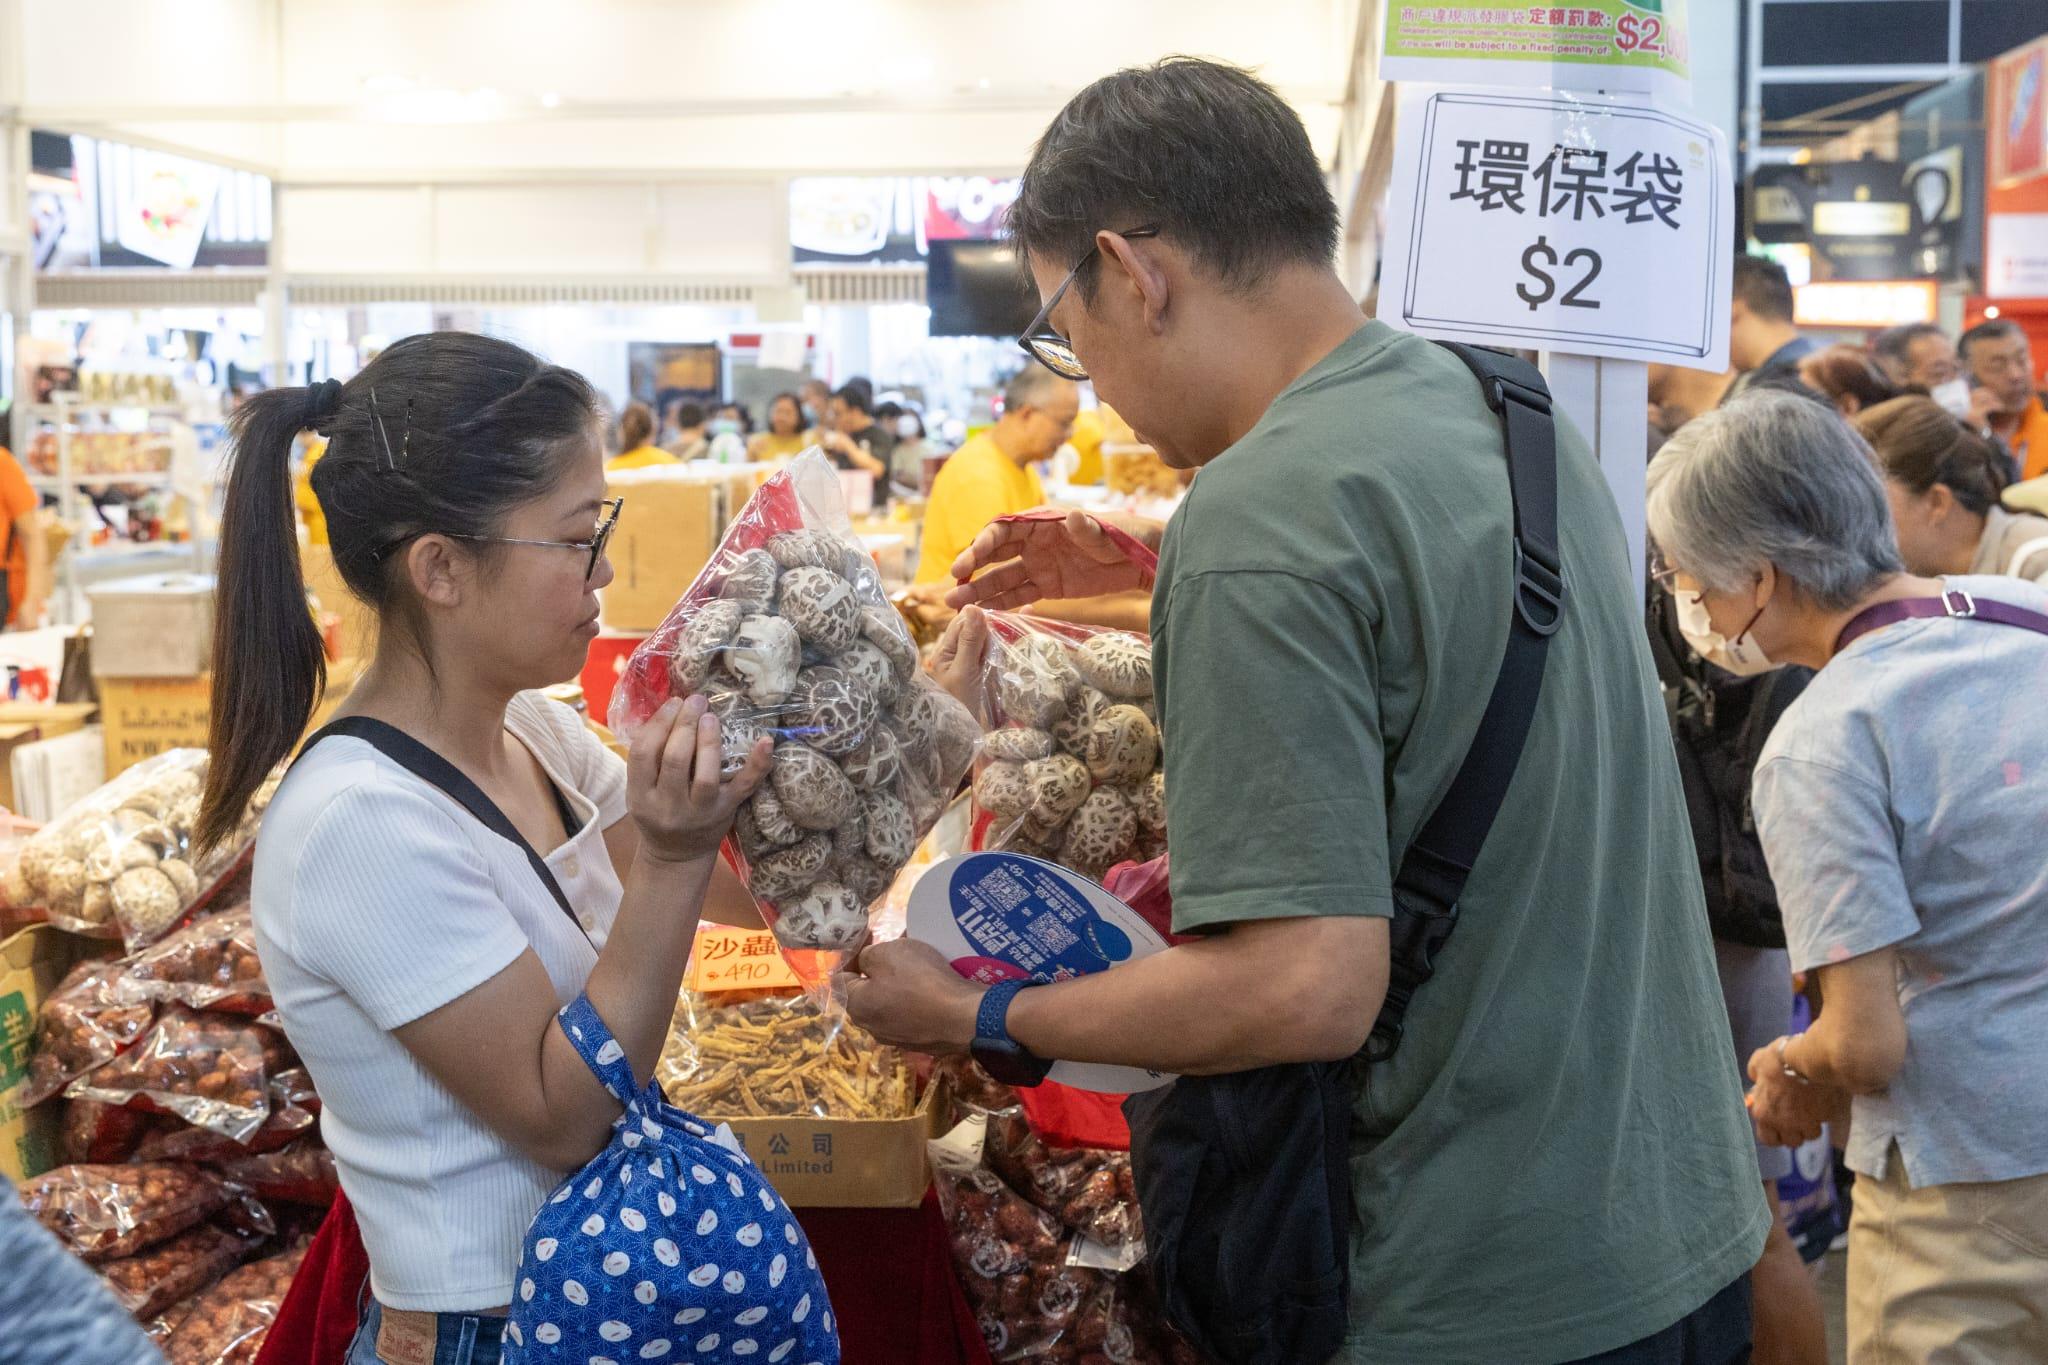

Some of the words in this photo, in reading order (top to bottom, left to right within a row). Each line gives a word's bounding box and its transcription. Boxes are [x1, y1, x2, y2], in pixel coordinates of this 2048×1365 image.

[1435, 40, 1451, 48] will
[1455, 41, 1466, 49] be
[1469, 42, 1505, 51] subject
[1530, 43, 1553, 52] fixed
[1558, 45, 1593, 55] penalty
[1450, 139, 1683, 230] 環保袋
[1516, 236, 1602, 311] $2
[761, 1160, 833, 1174] Limited
